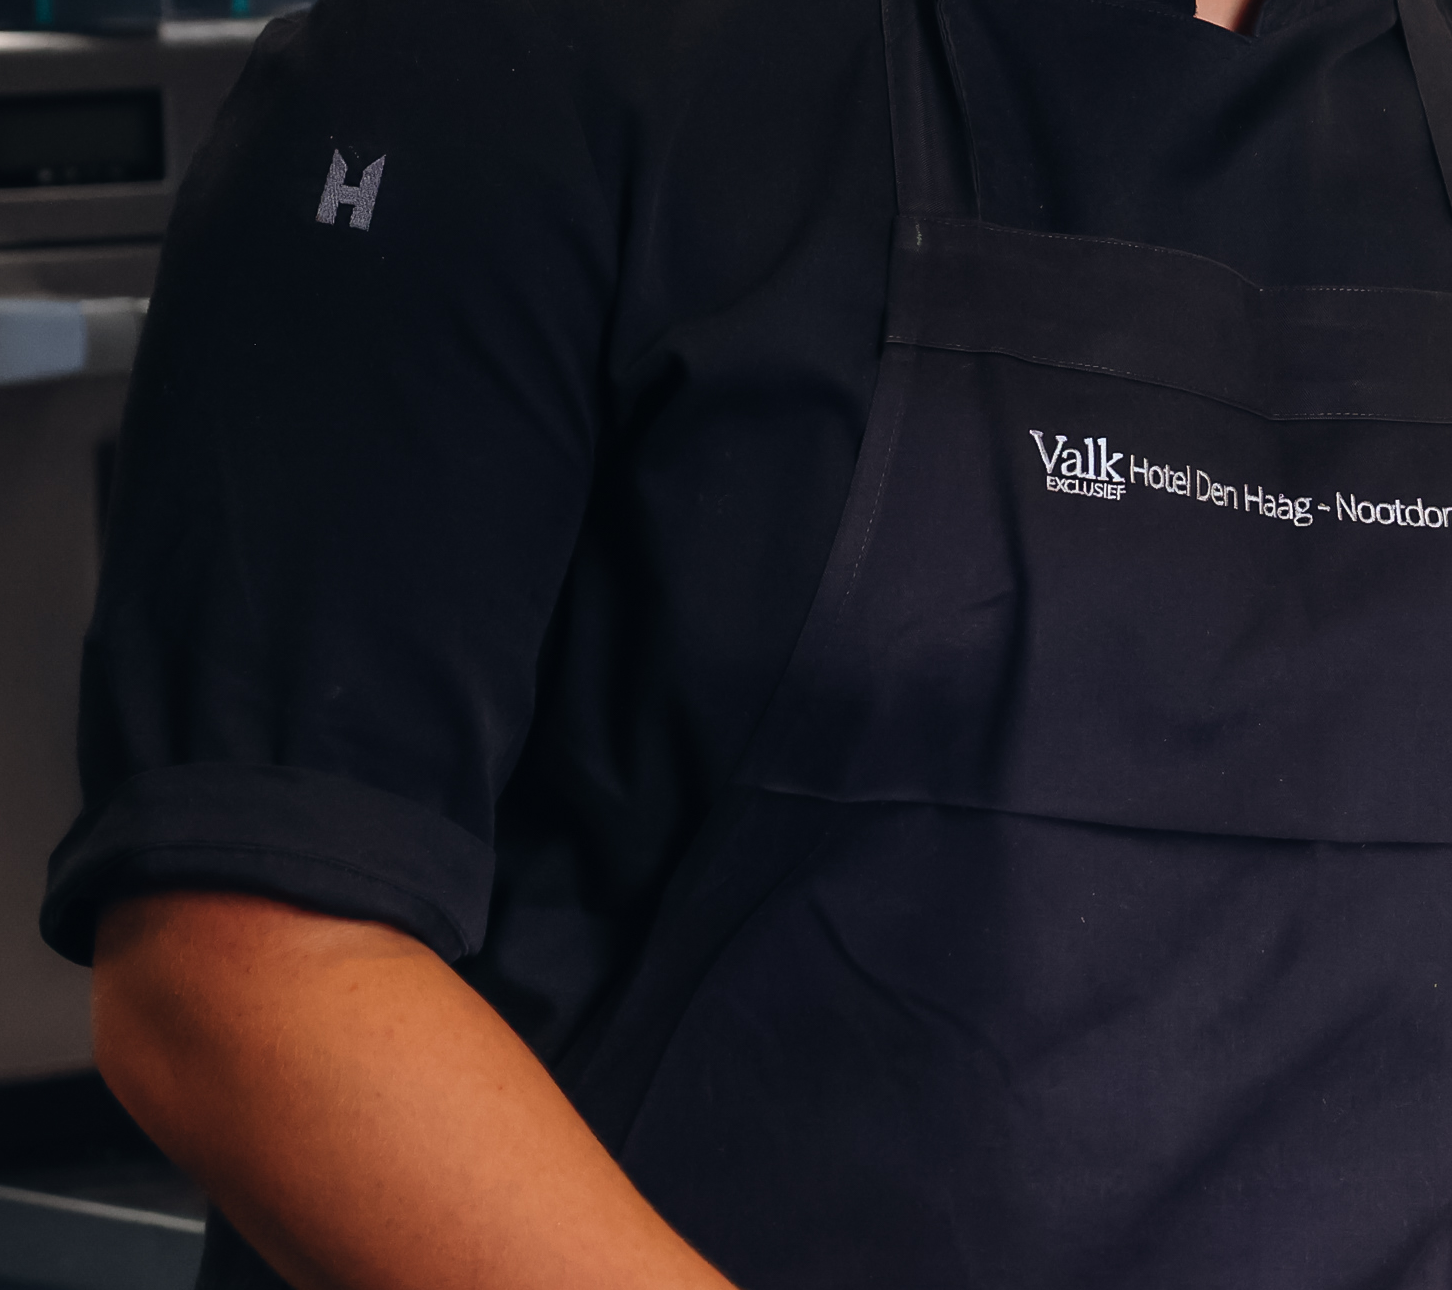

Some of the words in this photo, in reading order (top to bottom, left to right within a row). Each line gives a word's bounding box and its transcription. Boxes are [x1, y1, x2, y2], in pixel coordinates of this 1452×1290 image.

[1028, 429, 1126, 483] Valk
[1046, 475, 1127, 501] EXCLUSIEF
[1129, 454, 1191, 497] Hotel
[1196, 469, 1239, 510] Den
[1244, 483, 1314, 527] Haag
